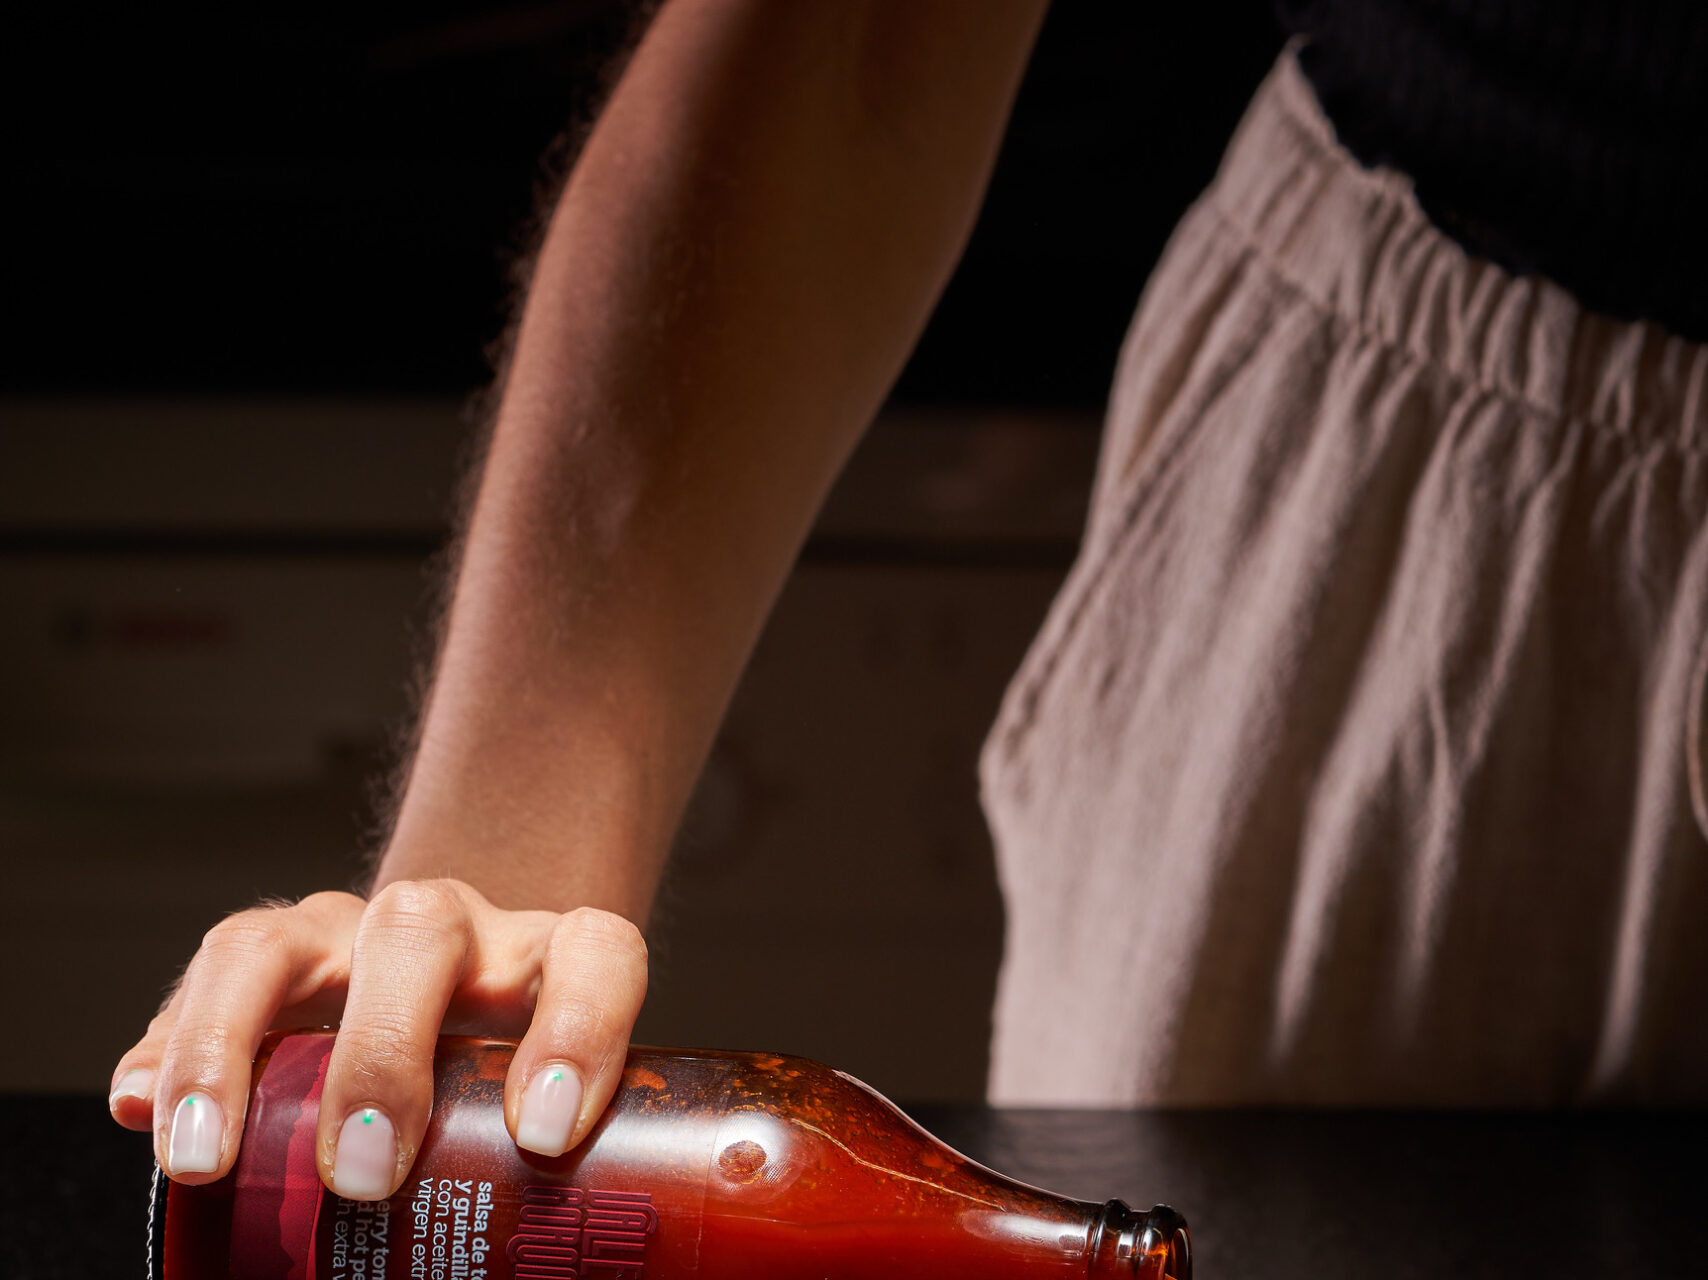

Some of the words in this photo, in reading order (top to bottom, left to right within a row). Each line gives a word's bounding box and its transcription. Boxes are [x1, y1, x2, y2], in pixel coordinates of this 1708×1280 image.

[435, 1179, 453, 1217] con
[454, 1179, 474, 1194] y
[473, 1181, 494, 1232] salsa
[370, 1200, 391, 1243] erry
[412, 1177, 436, 1240] virgen
[332, 1220, 351, 1269] extra
[353, 1218, 374, 1255] hot
[430, 1221, 449, 1280] aceite
[471, 1237, 491, 1264] de
